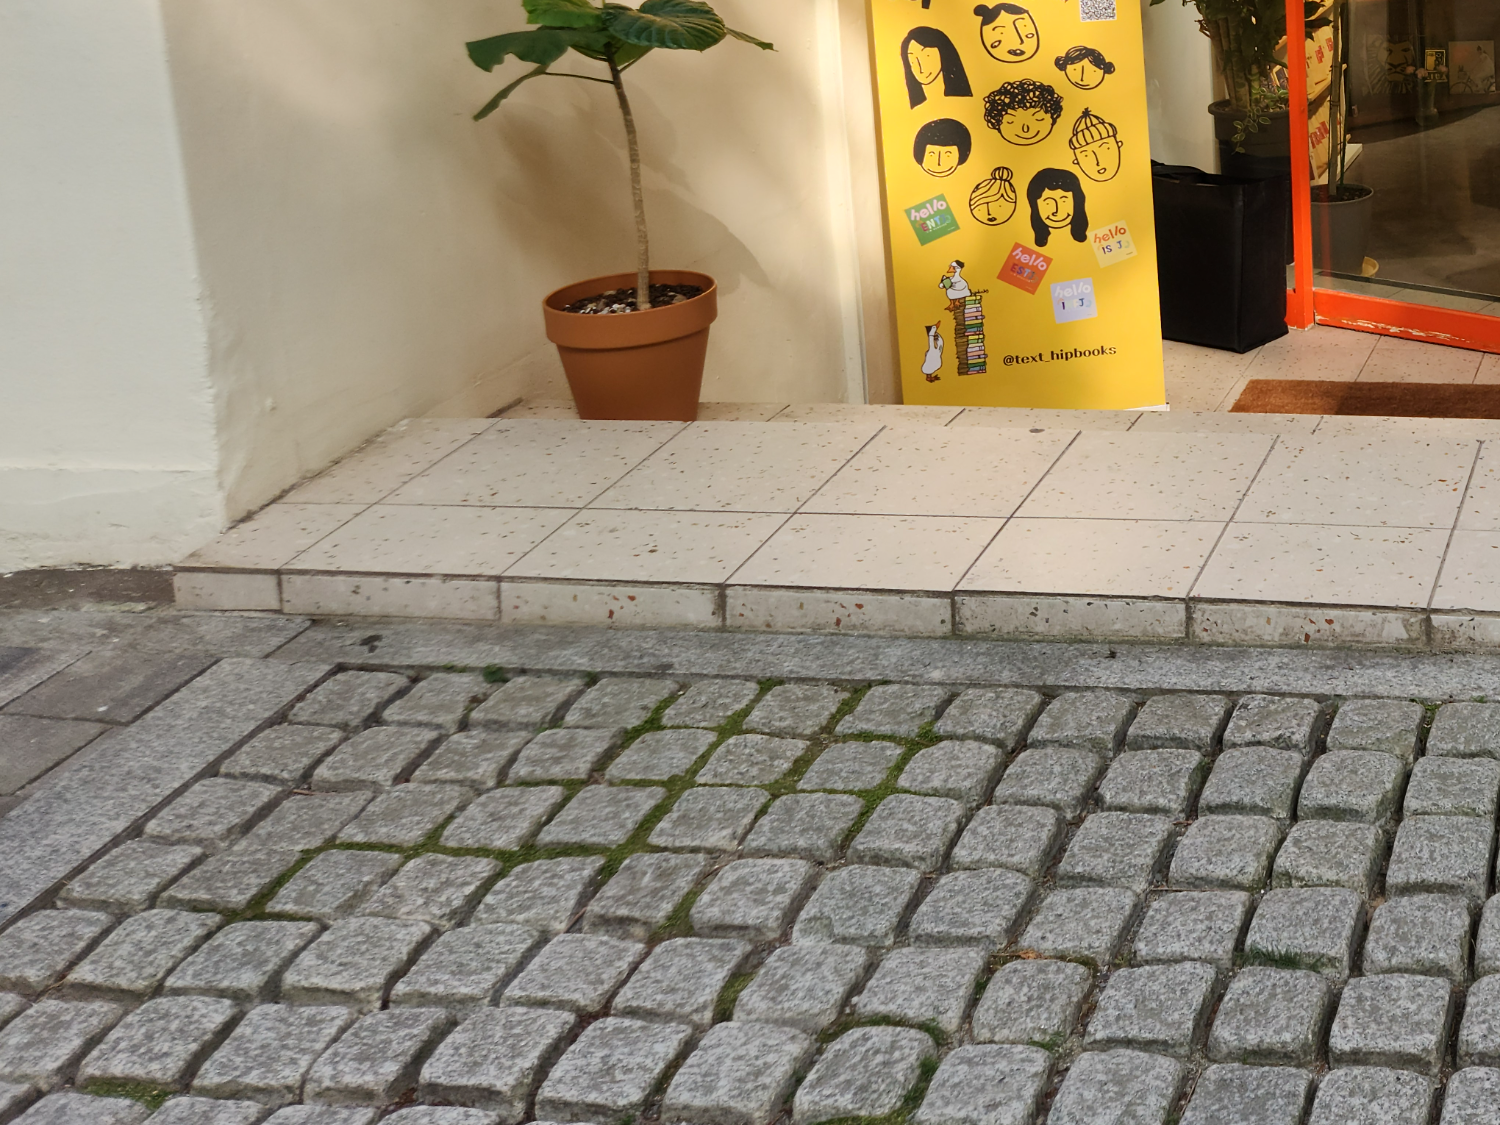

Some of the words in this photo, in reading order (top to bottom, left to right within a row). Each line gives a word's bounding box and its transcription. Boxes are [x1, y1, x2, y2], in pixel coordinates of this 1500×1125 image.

[911, 199, 947, 221] hello
[1093, 225, 1127, 244] hello
[1102, 240, 1123, 255] ISJ
[1012, 247, 1047, 271] hello
[1054, 281, 1091, 298] hello
[1061, 297, 1085, 310] IFJ
[1003, 345, 1117, 367] @text_hipbooks
